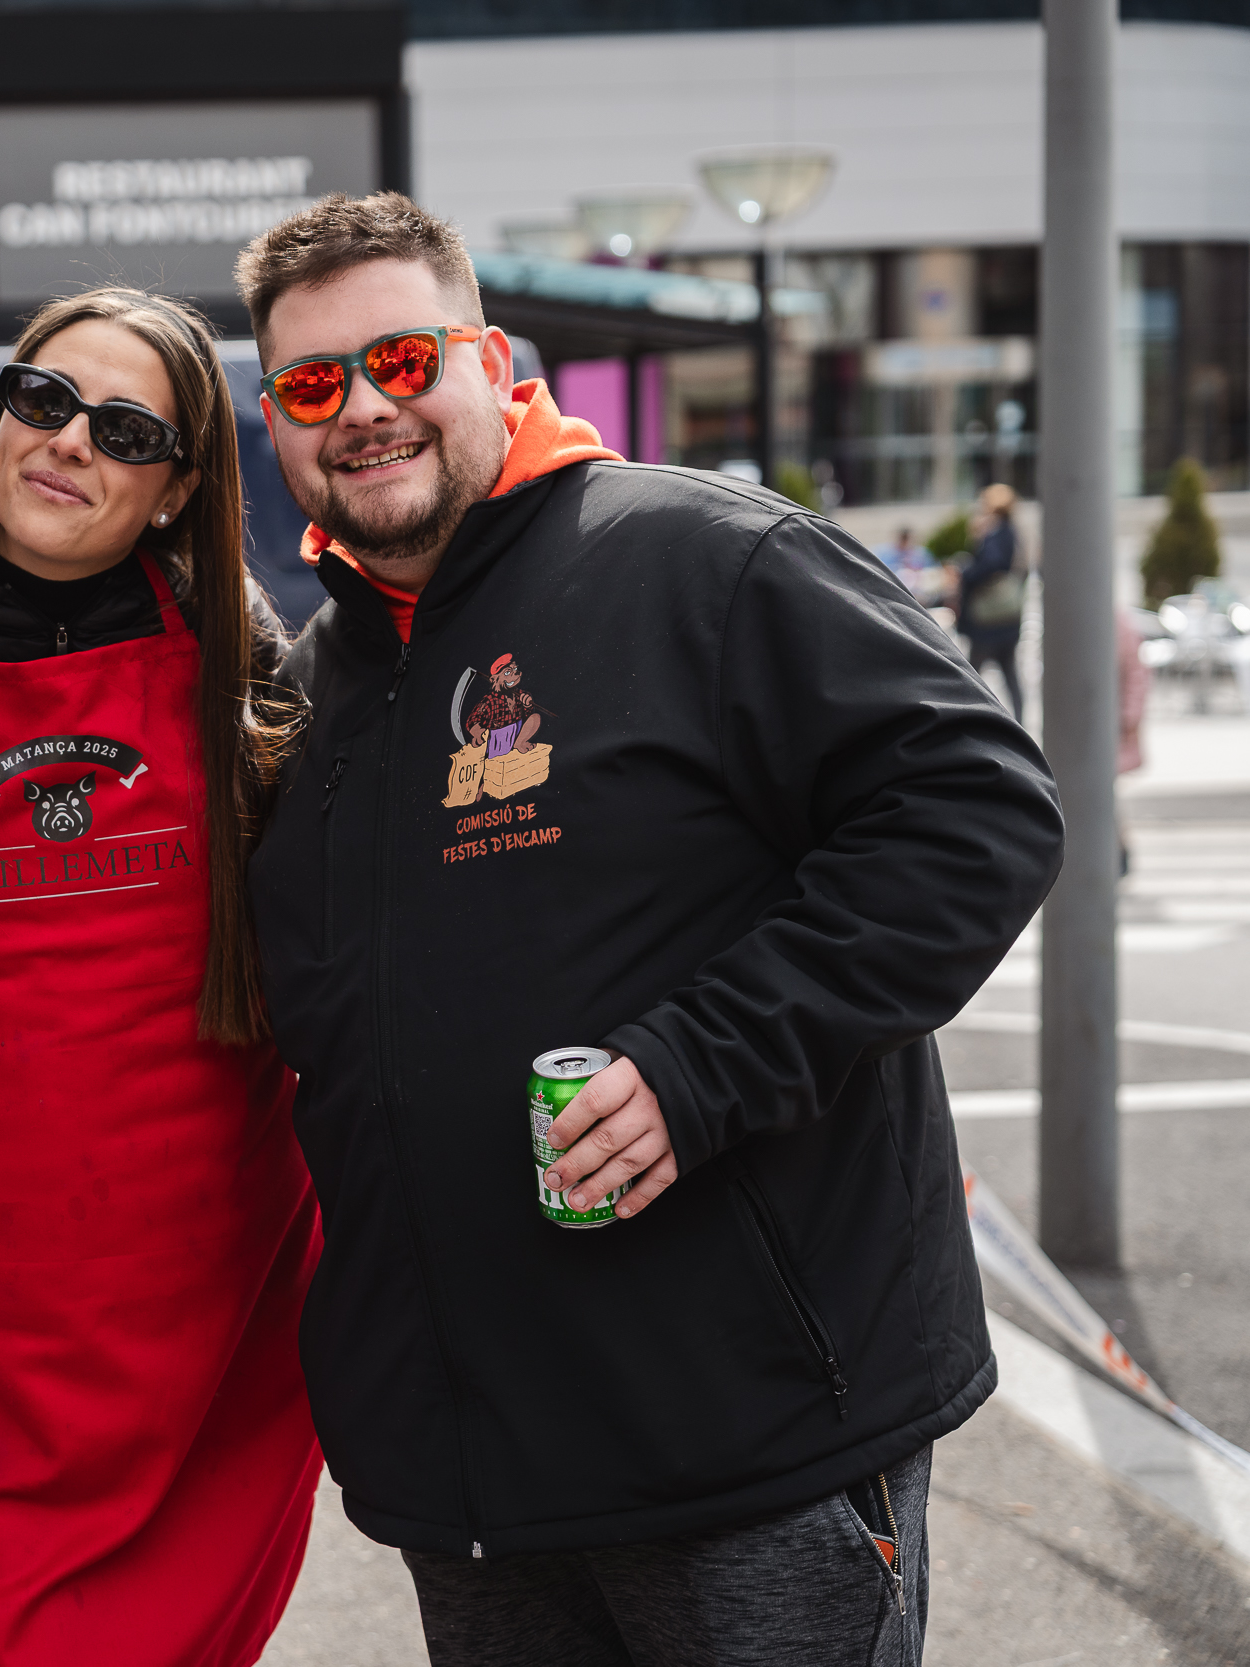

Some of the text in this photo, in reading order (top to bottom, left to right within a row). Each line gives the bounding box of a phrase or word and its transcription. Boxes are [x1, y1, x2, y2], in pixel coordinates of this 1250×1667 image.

[54, 157, 312, 200] RESTAURANT
[1, 741, 119, 771] MATANÇA 2025
[459, 763, 478, 784] CDF
[456, 803, 537, 834] COMISSIÓ DE
[443, 827, 562, 864] FESTES D'ENCAMP
